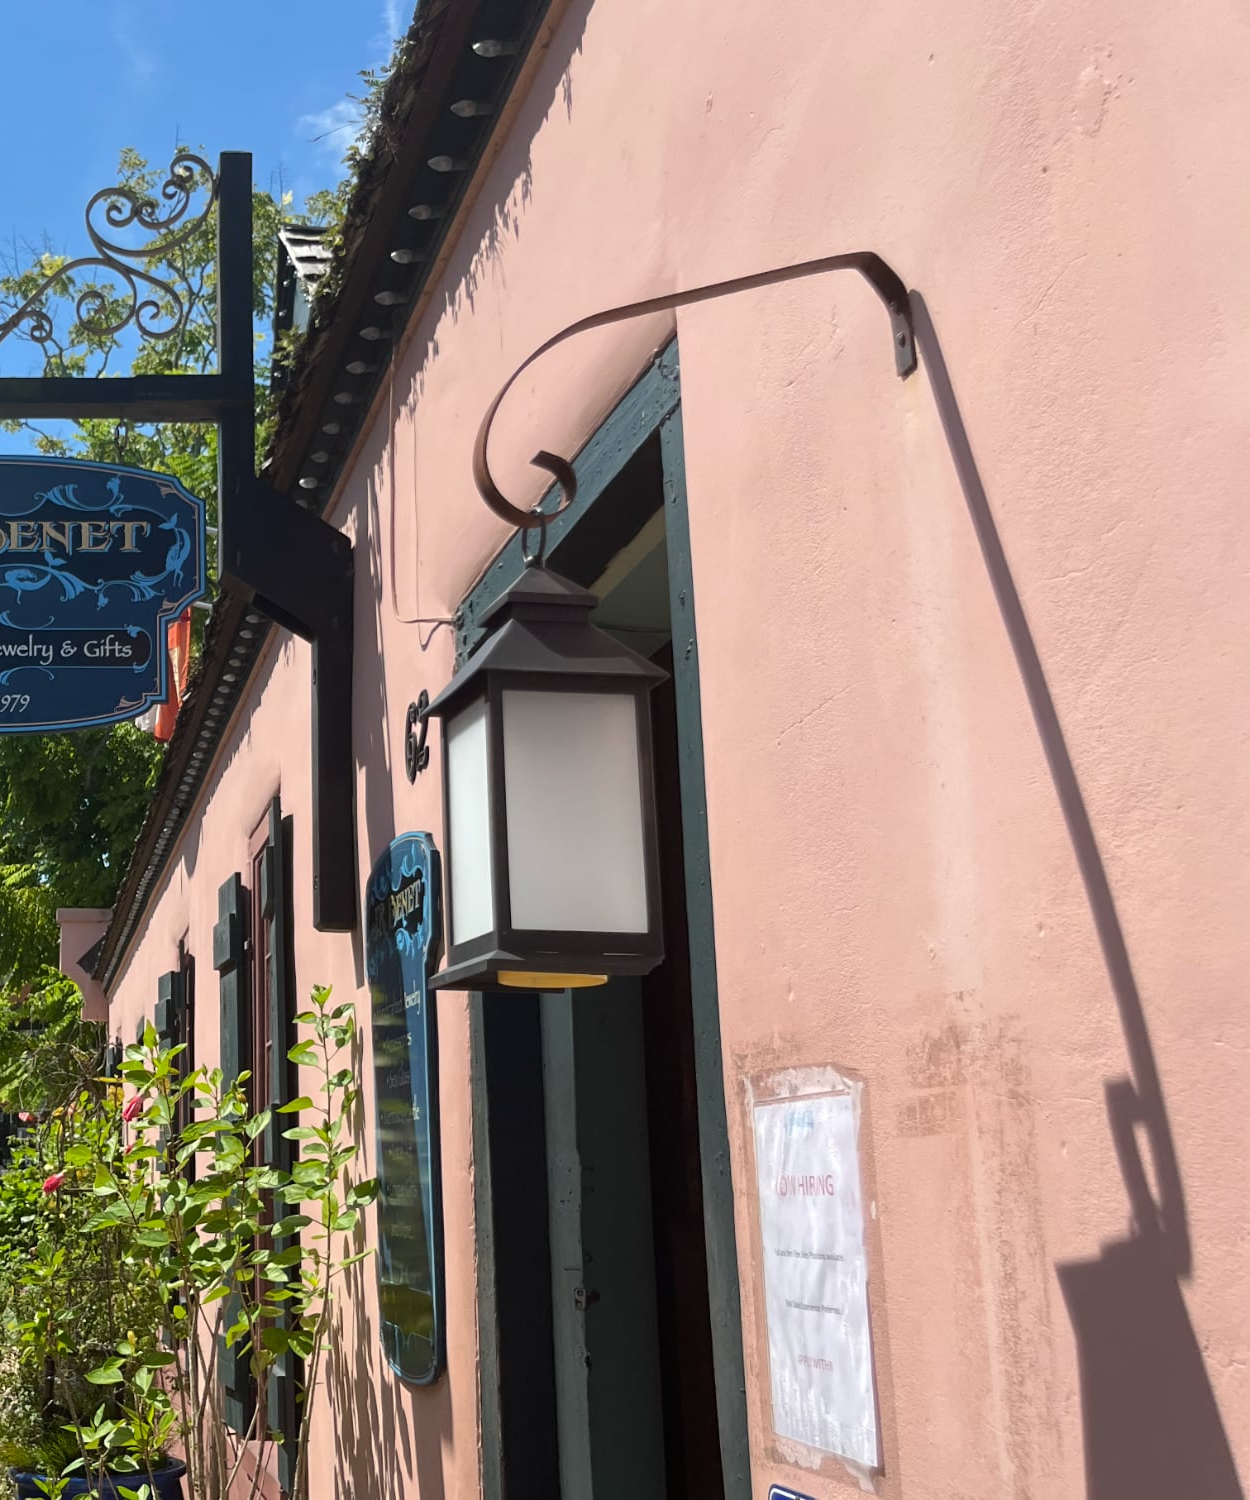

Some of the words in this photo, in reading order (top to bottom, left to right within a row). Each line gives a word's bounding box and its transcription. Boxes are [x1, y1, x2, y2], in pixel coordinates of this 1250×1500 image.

[61, 641, 78, 658] &
[83, 635, 133, 659] Gifts
[775, 1174, 796, 1197] OW
